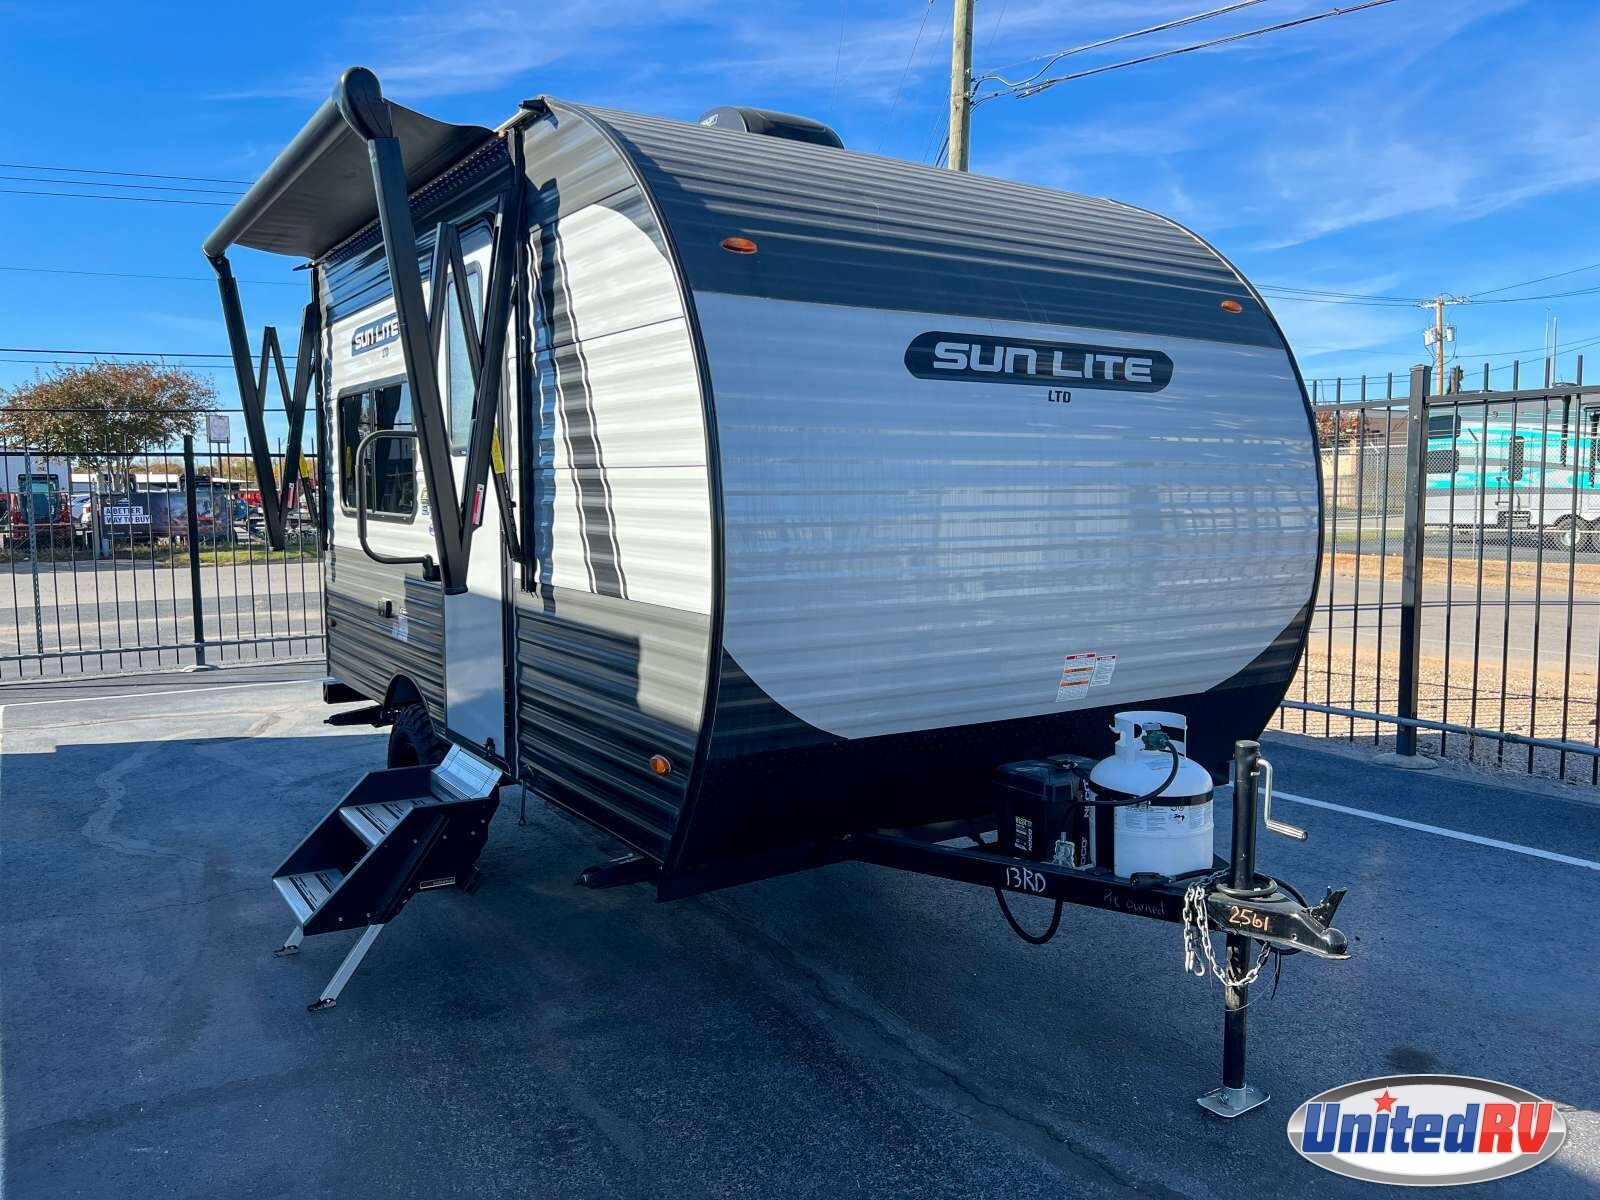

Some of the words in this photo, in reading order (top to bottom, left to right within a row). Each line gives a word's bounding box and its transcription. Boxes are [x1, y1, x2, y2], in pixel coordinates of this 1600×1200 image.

[933, 341, 1038, 374] SUN
[1052, 351, 1153, 382] LITE
[1047, 389, 1072, 404] LTD
[1228, 905, 1269, 931] 2561
